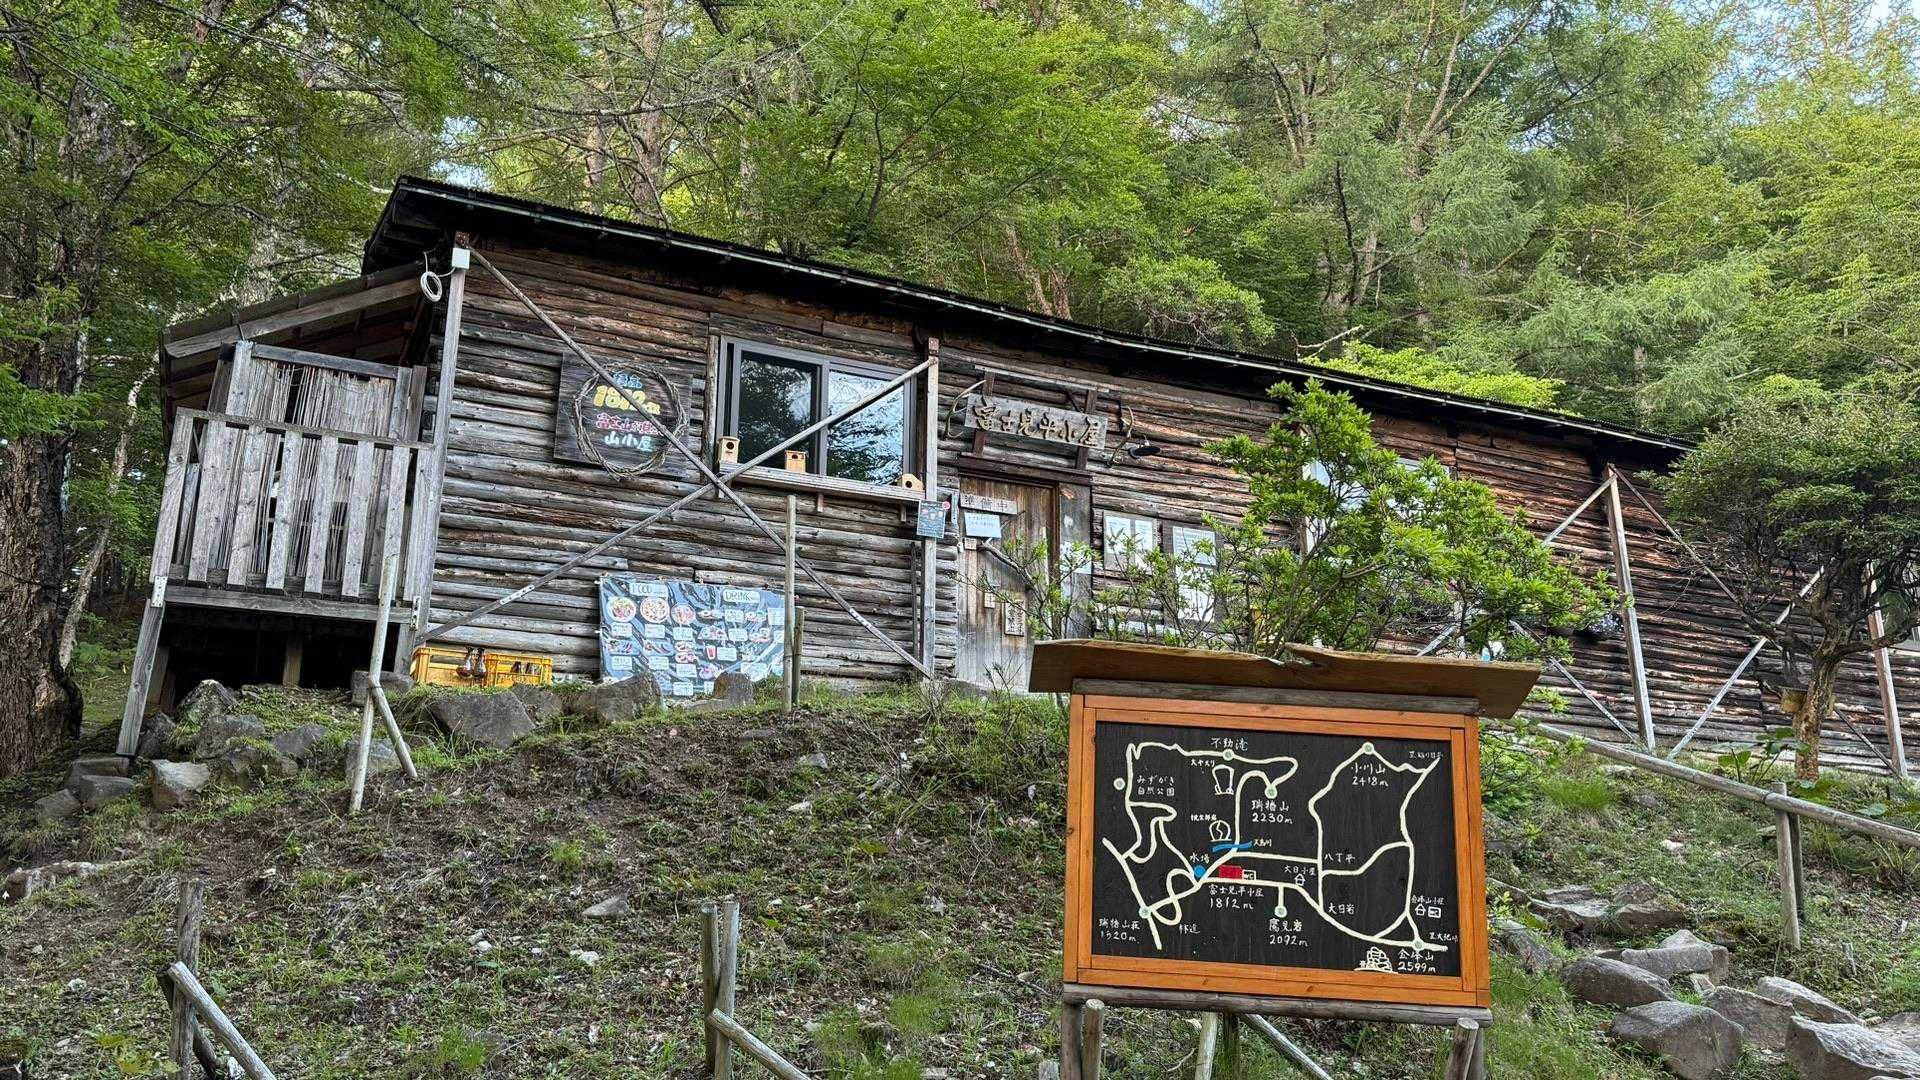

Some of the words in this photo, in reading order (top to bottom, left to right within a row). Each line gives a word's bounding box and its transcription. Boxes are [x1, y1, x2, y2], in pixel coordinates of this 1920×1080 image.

[972, 396, 1099, 446] 富士見平小屋
[604, 430, 653, 452] 山小屋
[1210, 738, 1248, 751] 不動滝
[1351, 762, 1386, 774] 小川山
[1137, 774, 1175, 787] みずがき
[1352, 776, 1389, 787] 2418m
[1137, 786, 1175, 796] 自然公園
[1252, 812, 1293, 825] 2230m
[1190, 852, 1210, 864] 水場
[1324, 852, 1356, 864] 八丁平
[1284, 865, 1316, 876] 大日小屋
[1208, 884, 1264, 897] 富士見平小屋
[1210, 897, 1254, 910] 1812m
[1328, 902, 1355, 914] 大日岩
[1179, 923, 1200, 934] 林道
[1269, 934, 1308, 947] 2092m
[1397, 961, 1436, 973] 2599m
